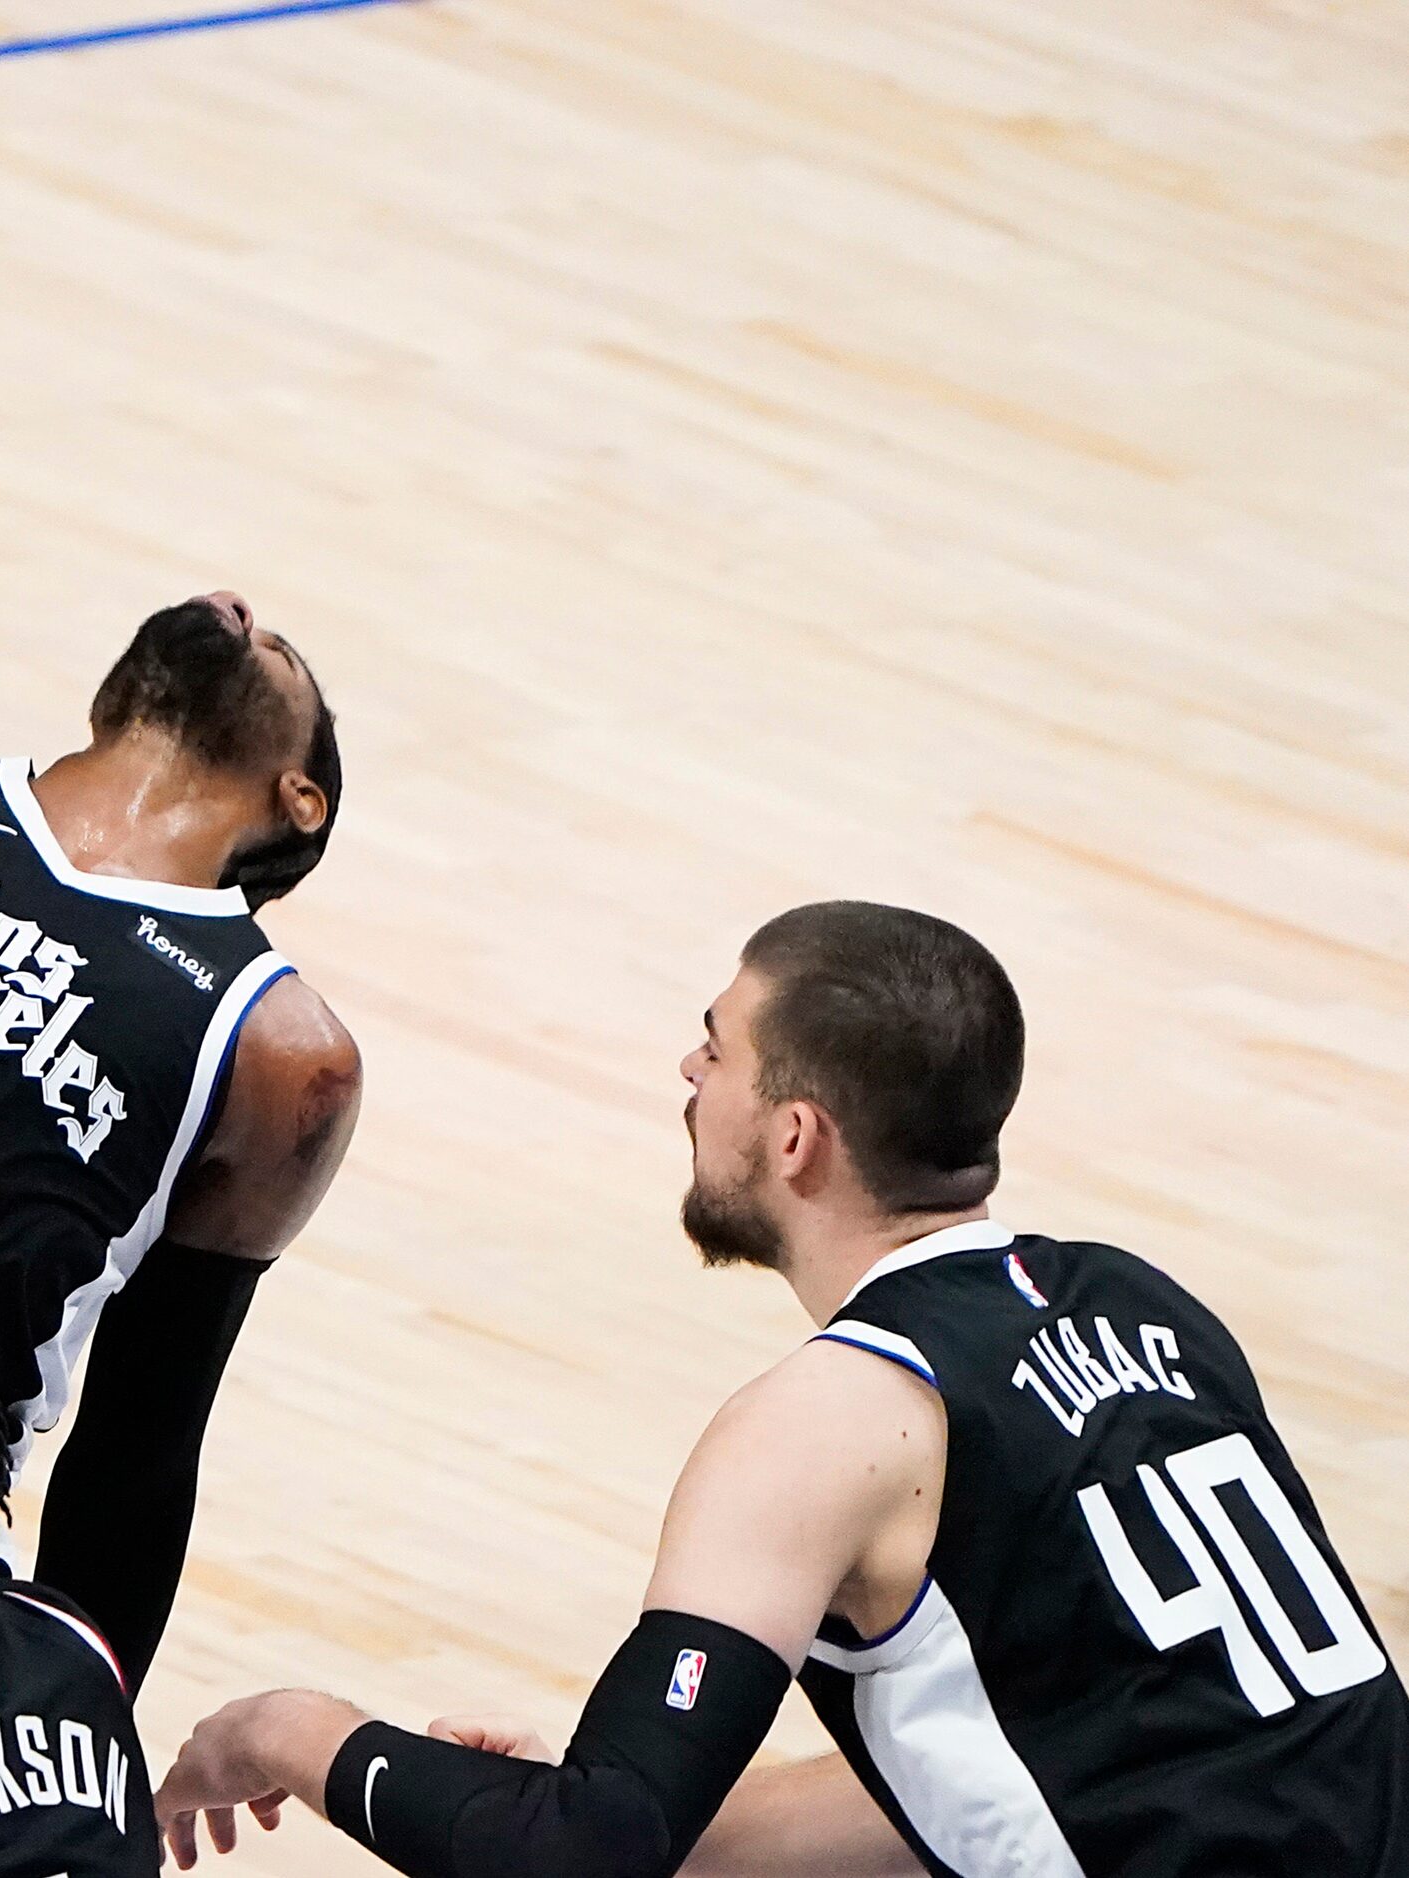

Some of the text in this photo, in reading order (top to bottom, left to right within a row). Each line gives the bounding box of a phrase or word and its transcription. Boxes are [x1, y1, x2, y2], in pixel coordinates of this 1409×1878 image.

[136, 914, 214, 992] honey
[1011, 1316, 1196, 1438] ZUBAC
[1077, 1432, 1387, 1718] 40
